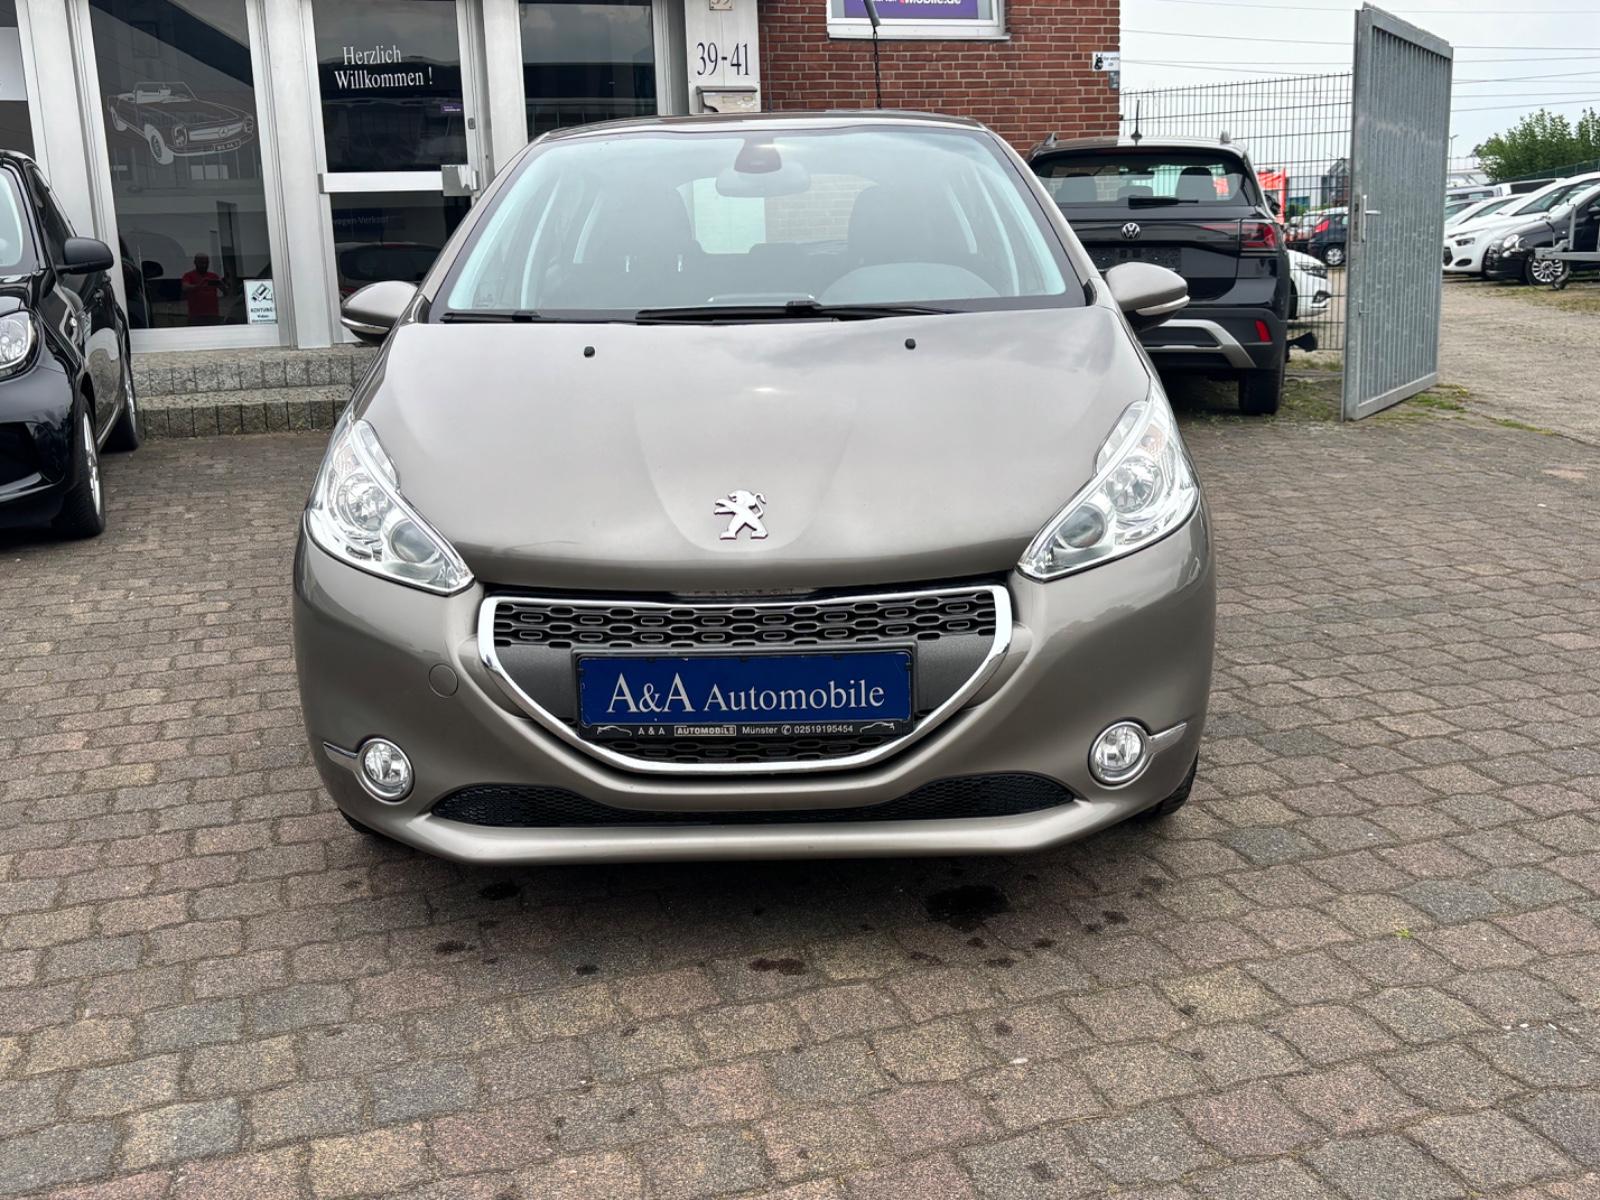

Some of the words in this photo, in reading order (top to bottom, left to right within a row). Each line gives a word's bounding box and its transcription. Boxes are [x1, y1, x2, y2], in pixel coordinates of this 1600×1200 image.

[343, 45, 402, 65] Herzlich
[696, 42, 750, 76] 39-41
[334, 70, 424, 89] Willkommen
[606, 672, 696, 713] A&A
[703, 679, 885, 712] Automobile
[638, 726, 645, 735] A
[648, 726, 655, 735] &
[658, 726, 665, 735] A
[677, 726, 735, 735] AUTOMOBILE
[742, 725, 778, 735] Münster
[793, 724, 854, 734] 02519195454
